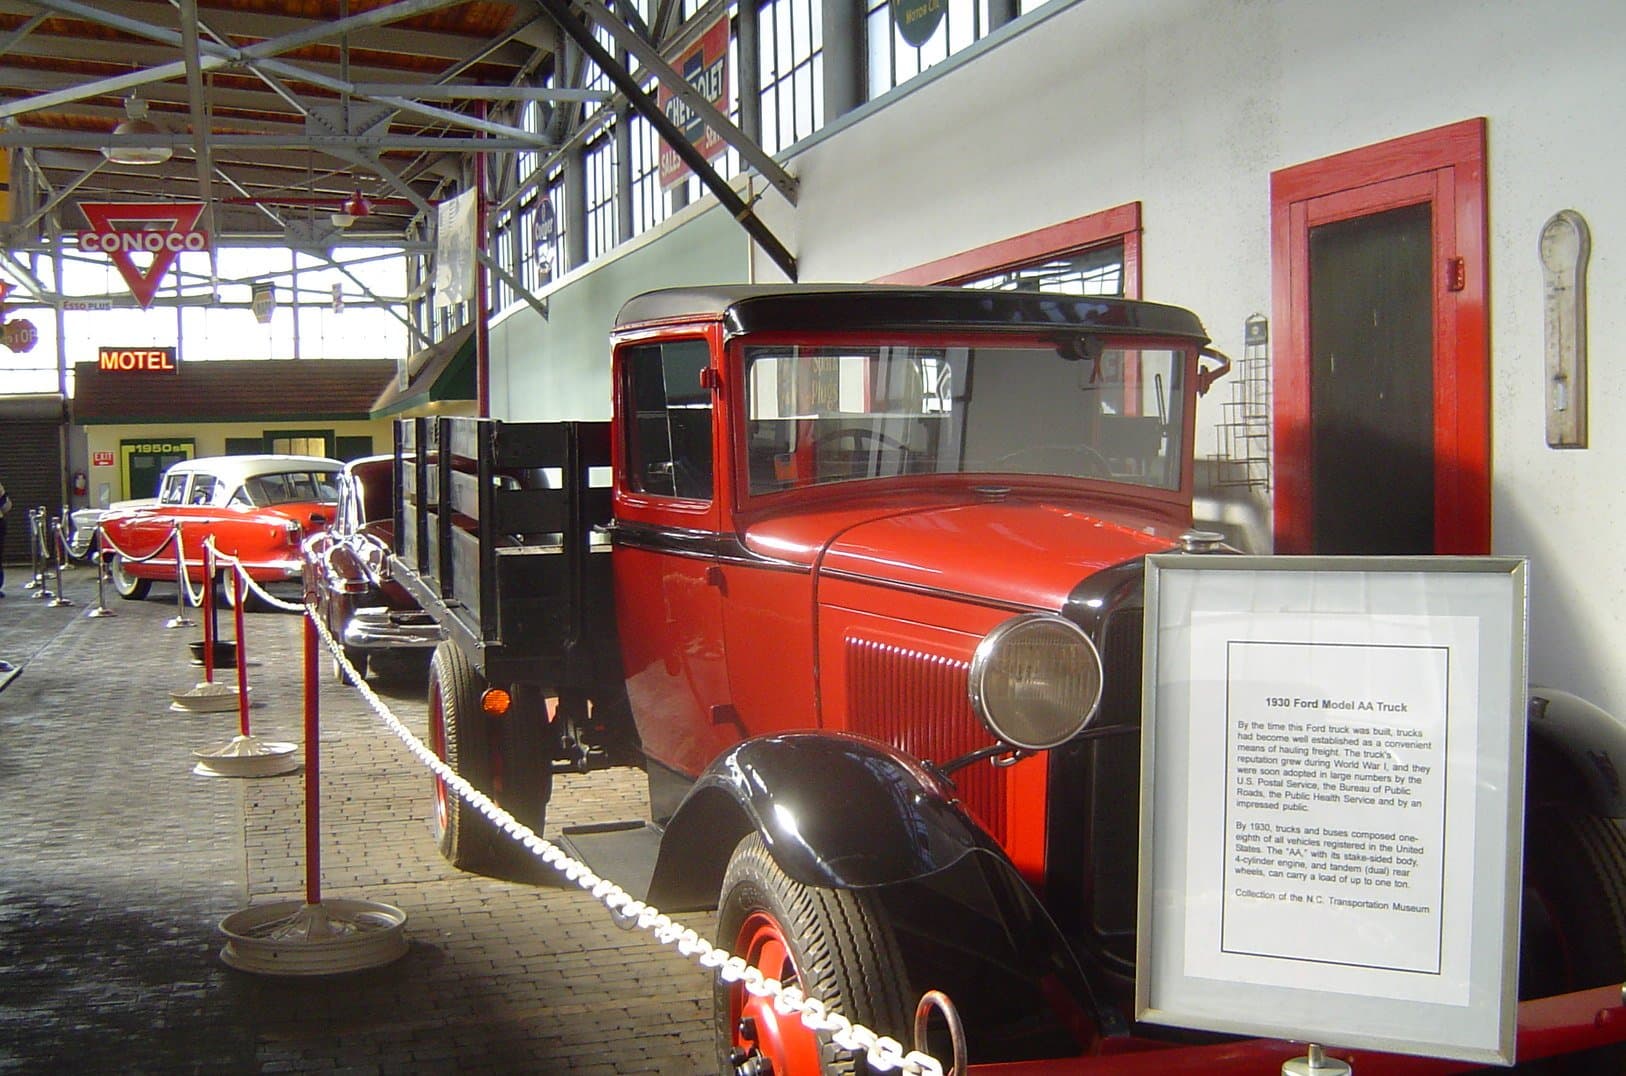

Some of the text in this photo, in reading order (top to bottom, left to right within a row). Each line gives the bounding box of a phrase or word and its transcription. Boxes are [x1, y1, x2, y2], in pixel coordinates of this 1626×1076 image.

[80, 232, 205, 252] CONOCO
[100, 351, 174, 370] MOTEL
[94, 452, 113, 461] EXIT
[1265, 697, 1408, 712] 1930 Ford Model AA Truck
[1237, 720, 1248, 730] By
[1251, 721, 1264, 730] the
[1267, 722, 1285, 731] time
[1288, 723, 1303, 732] this
[1306, 724, 1326, 733] Ford
[1328, 725, 1349, 734] truck
[1353, 727, 1370, 735] was
[1396, 729, 1423, 738] trucks
[1237, 732, 1253, 741] had
[1256, 733, 1289, 742] become
[1292, 735, 1308, 743] well
[1311, 736, 1359, 746] established
[1362, 739, 1373, 747] as
[1384, 740, 1432, 750] convenient
[1237, 745, 1265, 753] means
[1268, 744, 1277, 753] of
[1279, 745, 1309, 757] hauling
[1344, 748, 1360, 757] The
[1363, 750, 1392, 759] truck's
[1237, 755, 1278, 765] reputation
[1281, 758, 1301, 766] grew
[1304, 758, 1330, 769] during
[1334, 760, 1359, 769] World
[1362, 761, 1380, 770] War
[1392, 763, 1409, 772] and
[1412, 764, 1431, 775] they
[1282, 769, 1317, 778] adopted
[1330, 771, 1351, 781] large
[1354, 772, 1392, 782] numbers
[1394, 775, 1405, 784] by
[1408, 776, 1422, 784] the
[1257, 778, 1283, 787] Postal
[1286, 780, 1319, 790] Service,
[1322, 782, 1336, 790] the
[1339, 783, 1370, 792] Bureau
[1372, 785, 1382, 793] of
[1384, 785, 1411, 795] Public
[1236, 800, 1279, 809] impressed
[1268, 790, 1281, 798] the
[1285, 791, 1310, 800] Public
[1313, 793, 1340, 802] Health
[1343, 794, 1375, 804] Service
[1378, 797, 1394, 806] and
[1397, 799, 1408, 808] by
[1236, 821, 1246, 831] By
[1275, 824, 1301, 834] trucks
[1304, 827, 1320, 835] and
[1323, 828, 1348, 837] buses
[1351, 830, 1396, 841] composed
[1235, 834, 1424, 855] eighth of all vehicles registered in the United
[1267, 846, 1283, 855] The
[1311, 850, 1327, 859] with
[1330, 851, 1340, 860] its
[1344, 853, 1393, 864] stake-sided
[1235, 855, 1275, 865] 4-cylinder
[1311, 862, 1327, 870] and
[1330, 863, 1362, 873] tandem
[1364, 865, 1390, 876] (dual)
[1392, 869, 1411, 877] rear
[1268, 870, 1284, 878] can
[1286, 872, 1308, 882] carry
[1318, 873, 1336, 882] load
[1339, 875, 1348, 883] of
[1350, 877, 1361, 885] up
[1364, 877, 1372, 885] to
[1375, 879, 1392, 887] one
[1235, 888, 1275, 899] Collection
[1278, 892, 1287, 901] of
[1289, 894, 1303, 902] the
[1329, 897, 1389, 910] Transportation
[1392, 902, 1430, 913] Museum
